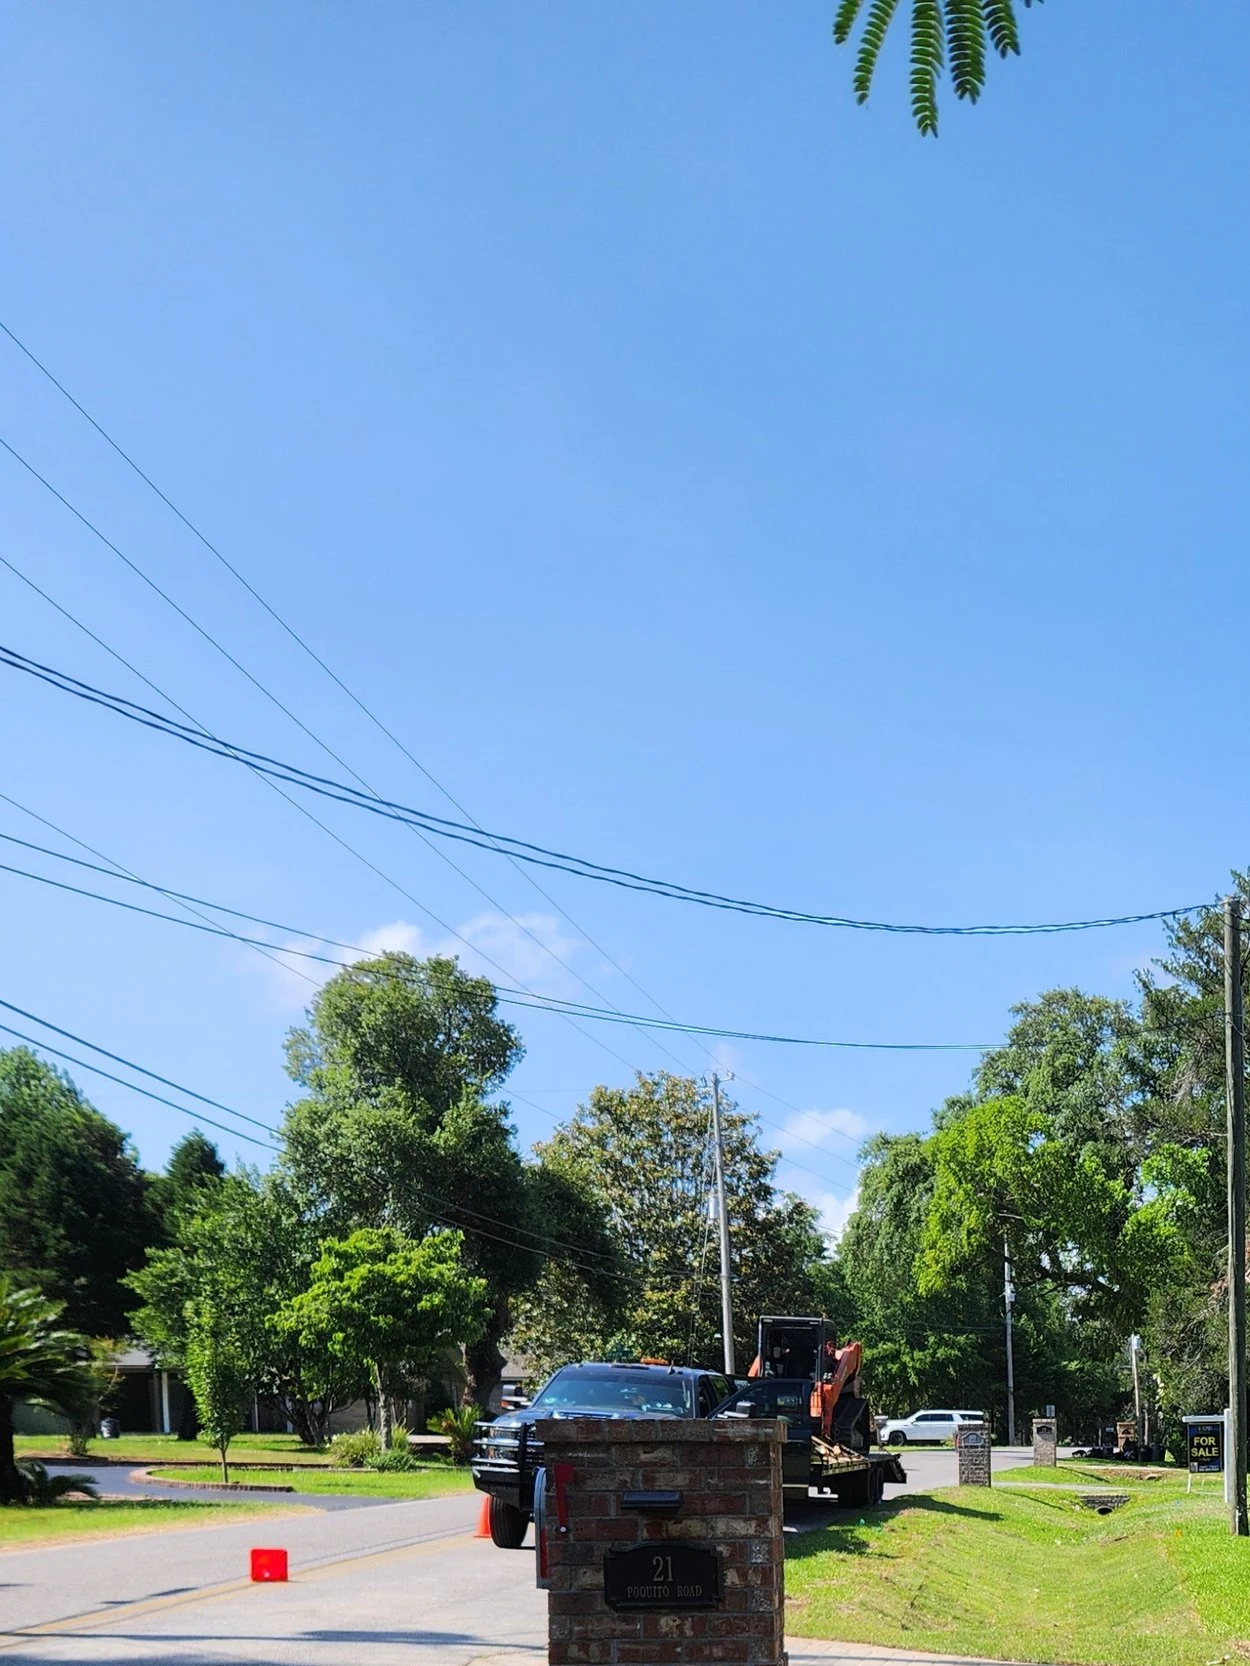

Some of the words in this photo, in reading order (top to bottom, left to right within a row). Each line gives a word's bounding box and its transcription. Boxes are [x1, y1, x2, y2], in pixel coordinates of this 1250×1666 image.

[1193, 1436, 1217, 1446] FOR
[1191, 1447, 1219, 1457] SALE
[652, 1556, 674, 1582] 21
[627, 1585, 670, 1598] POQUITO
[677, 1585, 702, 1598] ROAD
